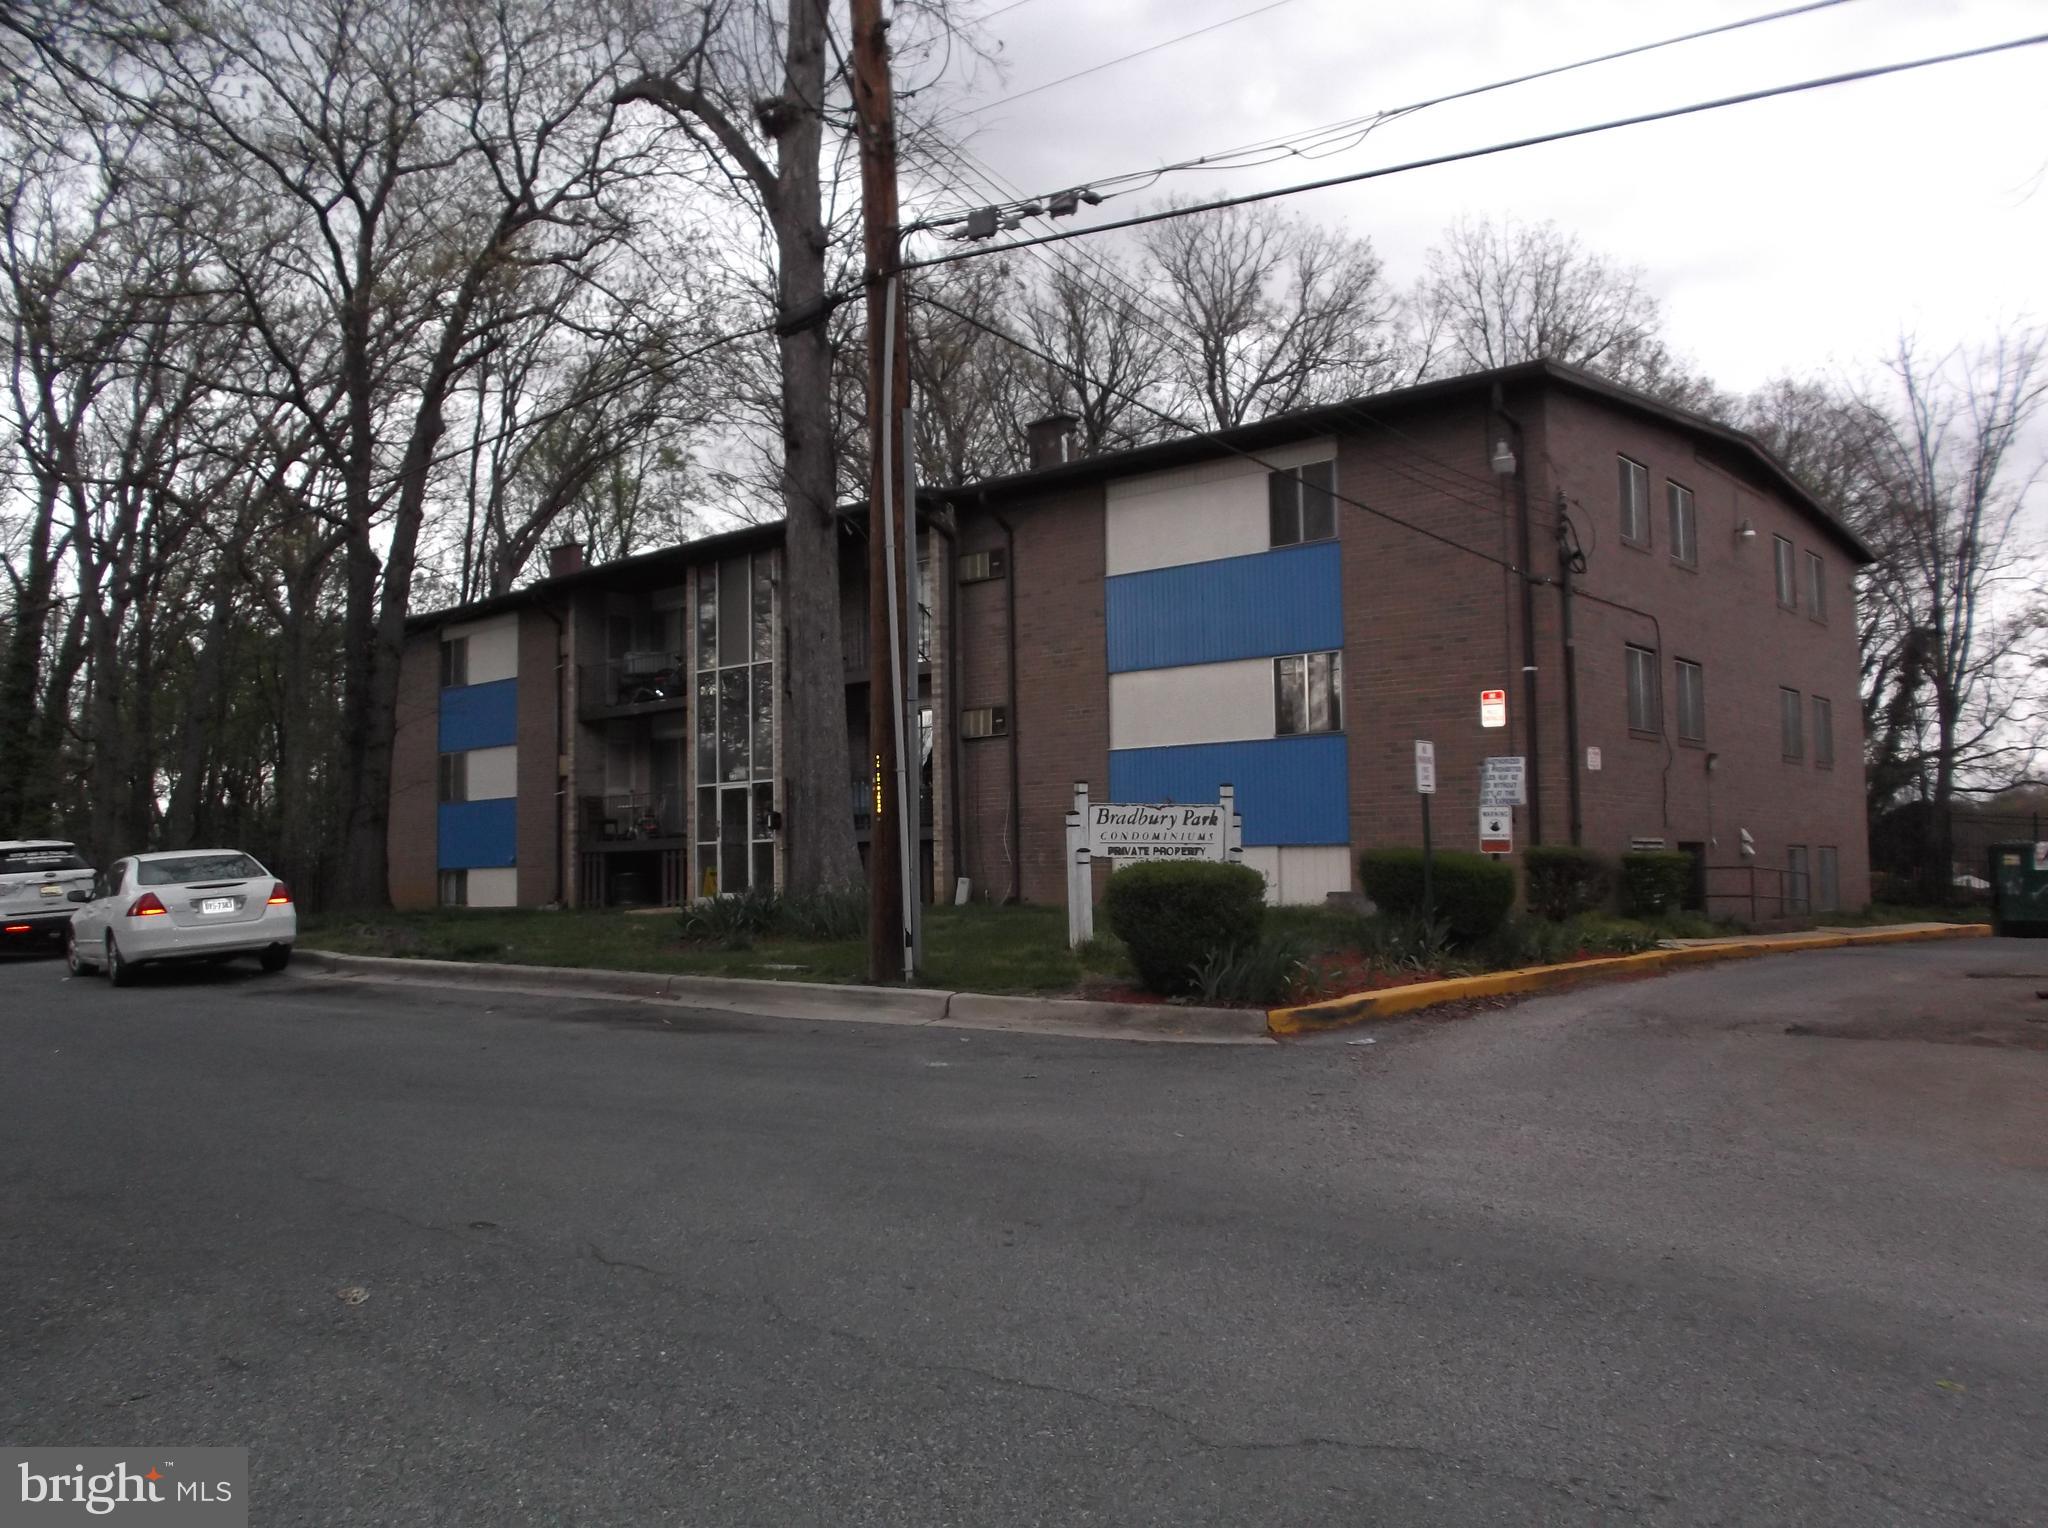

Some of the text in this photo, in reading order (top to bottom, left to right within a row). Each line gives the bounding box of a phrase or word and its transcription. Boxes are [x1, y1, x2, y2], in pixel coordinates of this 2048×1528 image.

[1096, 808, 1218, 830] Bradbury Park
[1100, 831, 1214, 841] CONDOMINIUMS
[1107, 846, 1206, 856] PRIVATE PROPERTY
